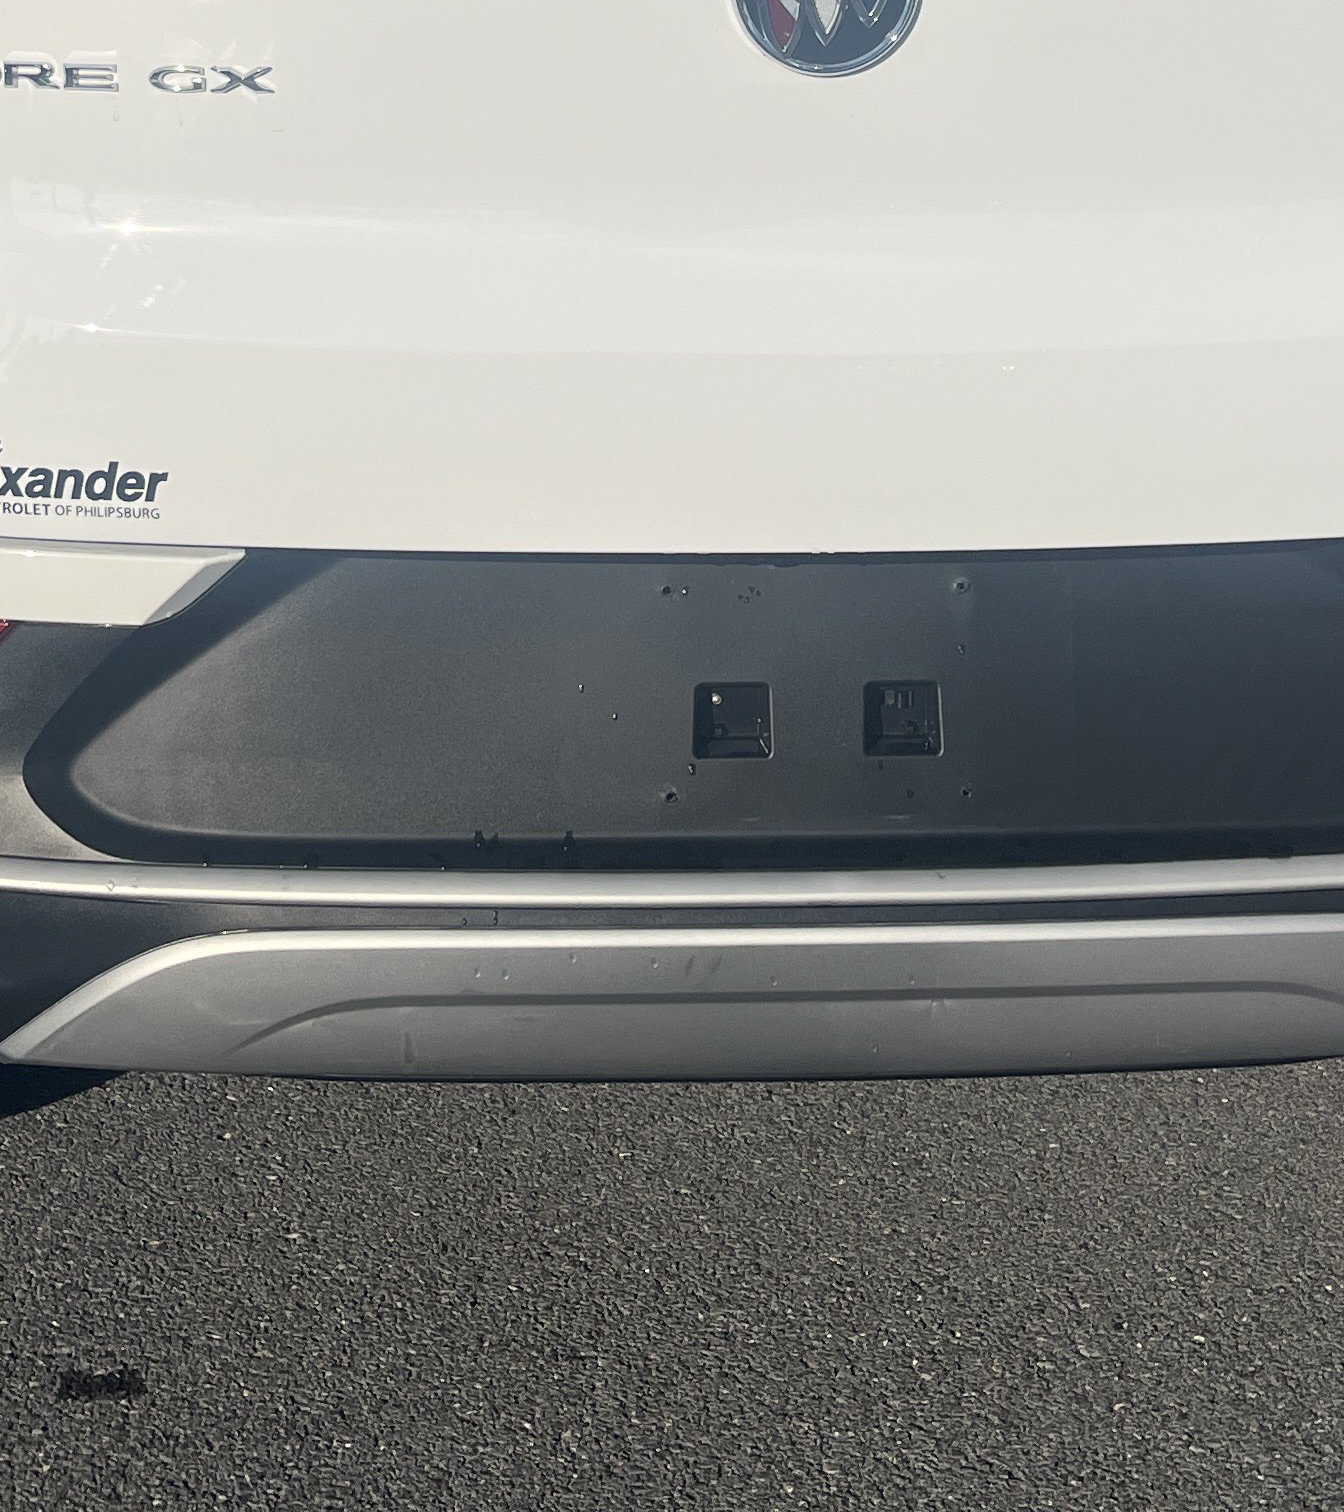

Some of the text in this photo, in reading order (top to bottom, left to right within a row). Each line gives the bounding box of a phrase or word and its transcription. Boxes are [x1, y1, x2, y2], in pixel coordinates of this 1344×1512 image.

[149, 65, 276, 94] GX
[55, 504, 73, 516] OF
[75, 506, 161, 520] PHILIPSBURG
